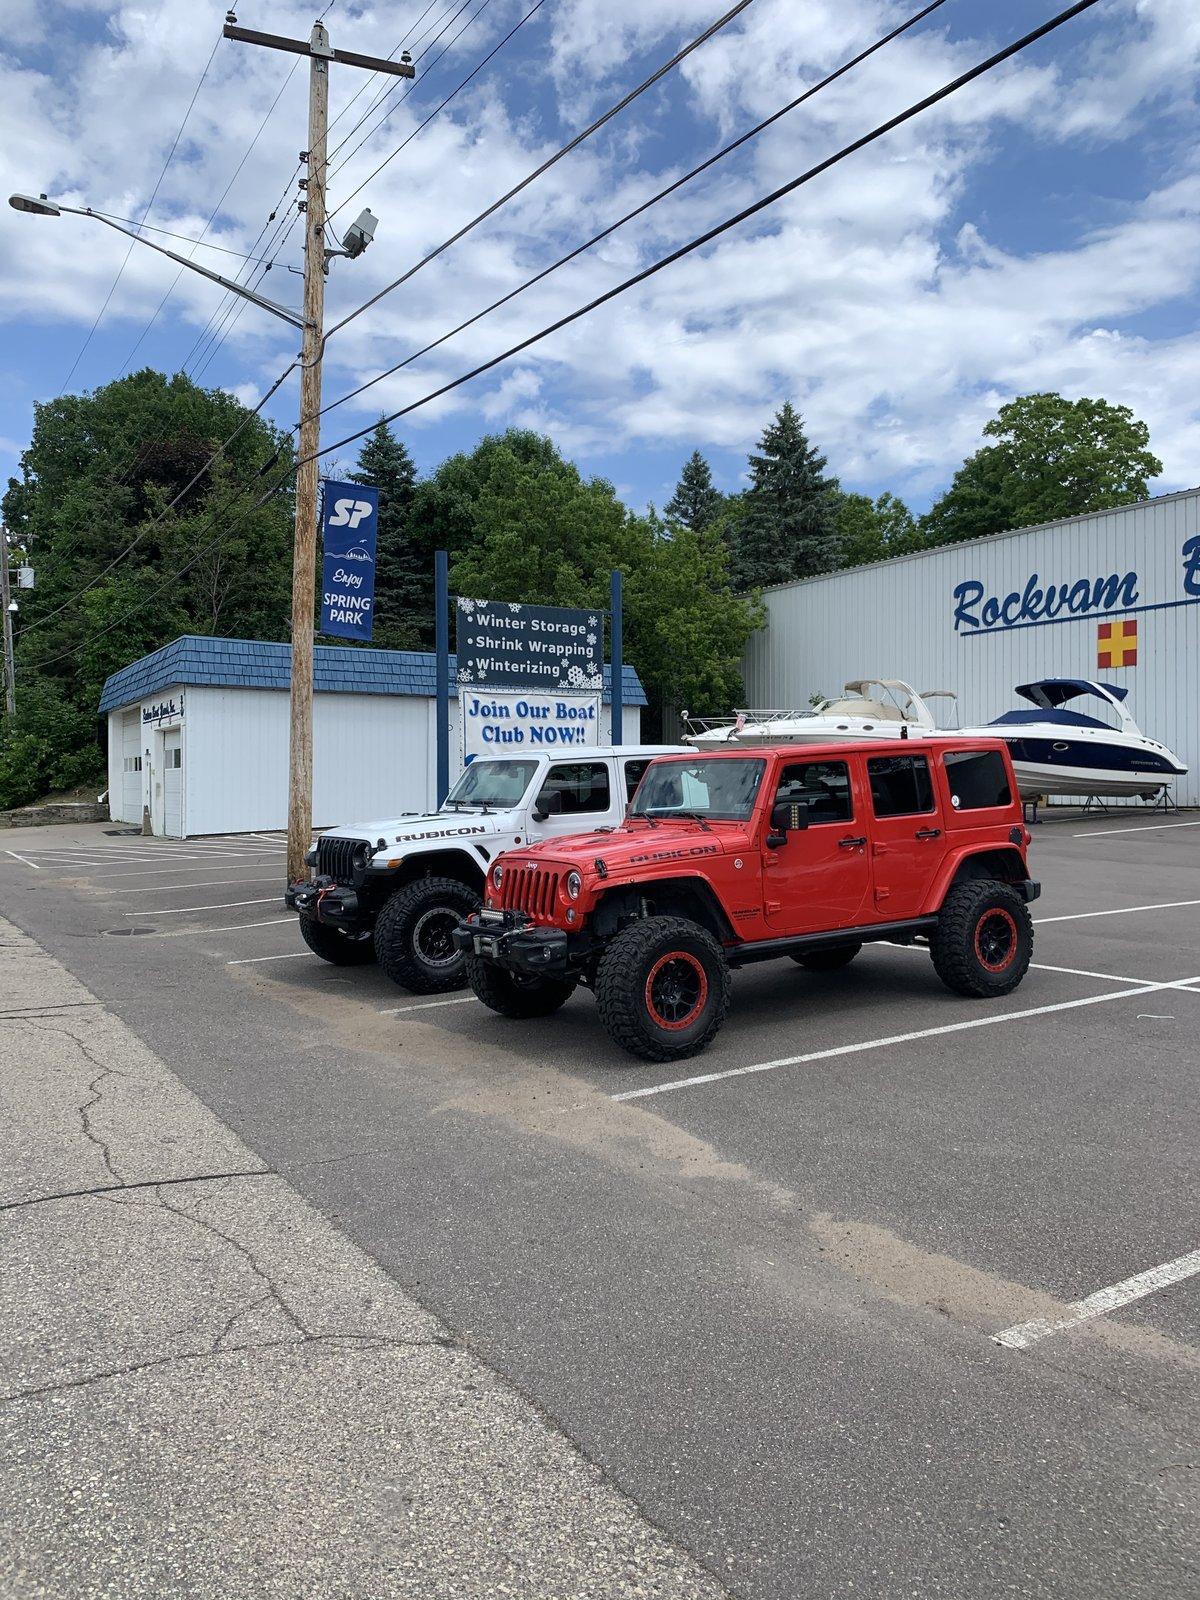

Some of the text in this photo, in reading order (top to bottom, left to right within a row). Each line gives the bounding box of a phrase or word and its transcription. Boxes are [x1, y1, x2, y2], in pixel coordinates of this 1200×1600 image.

[329, 498, 373, 529] SP
[332, 568, 363, 589] Enjoy
[323, 592, 371, 610] SPRING
[953, 571, 1139, 631] Rockvam
[330, 609, 363, 625] PARK
[476, 613, 586, 636] Winter Storage
[475, 636, 594, 658] Shrink Wrapping
[475, 657, 560, 677] Winterizing
[469, 699, 595, 720] Join Our Boat
[482, 725, 586, 744] Club NOW!!
[395, 826, 486, 843] RUBICON
